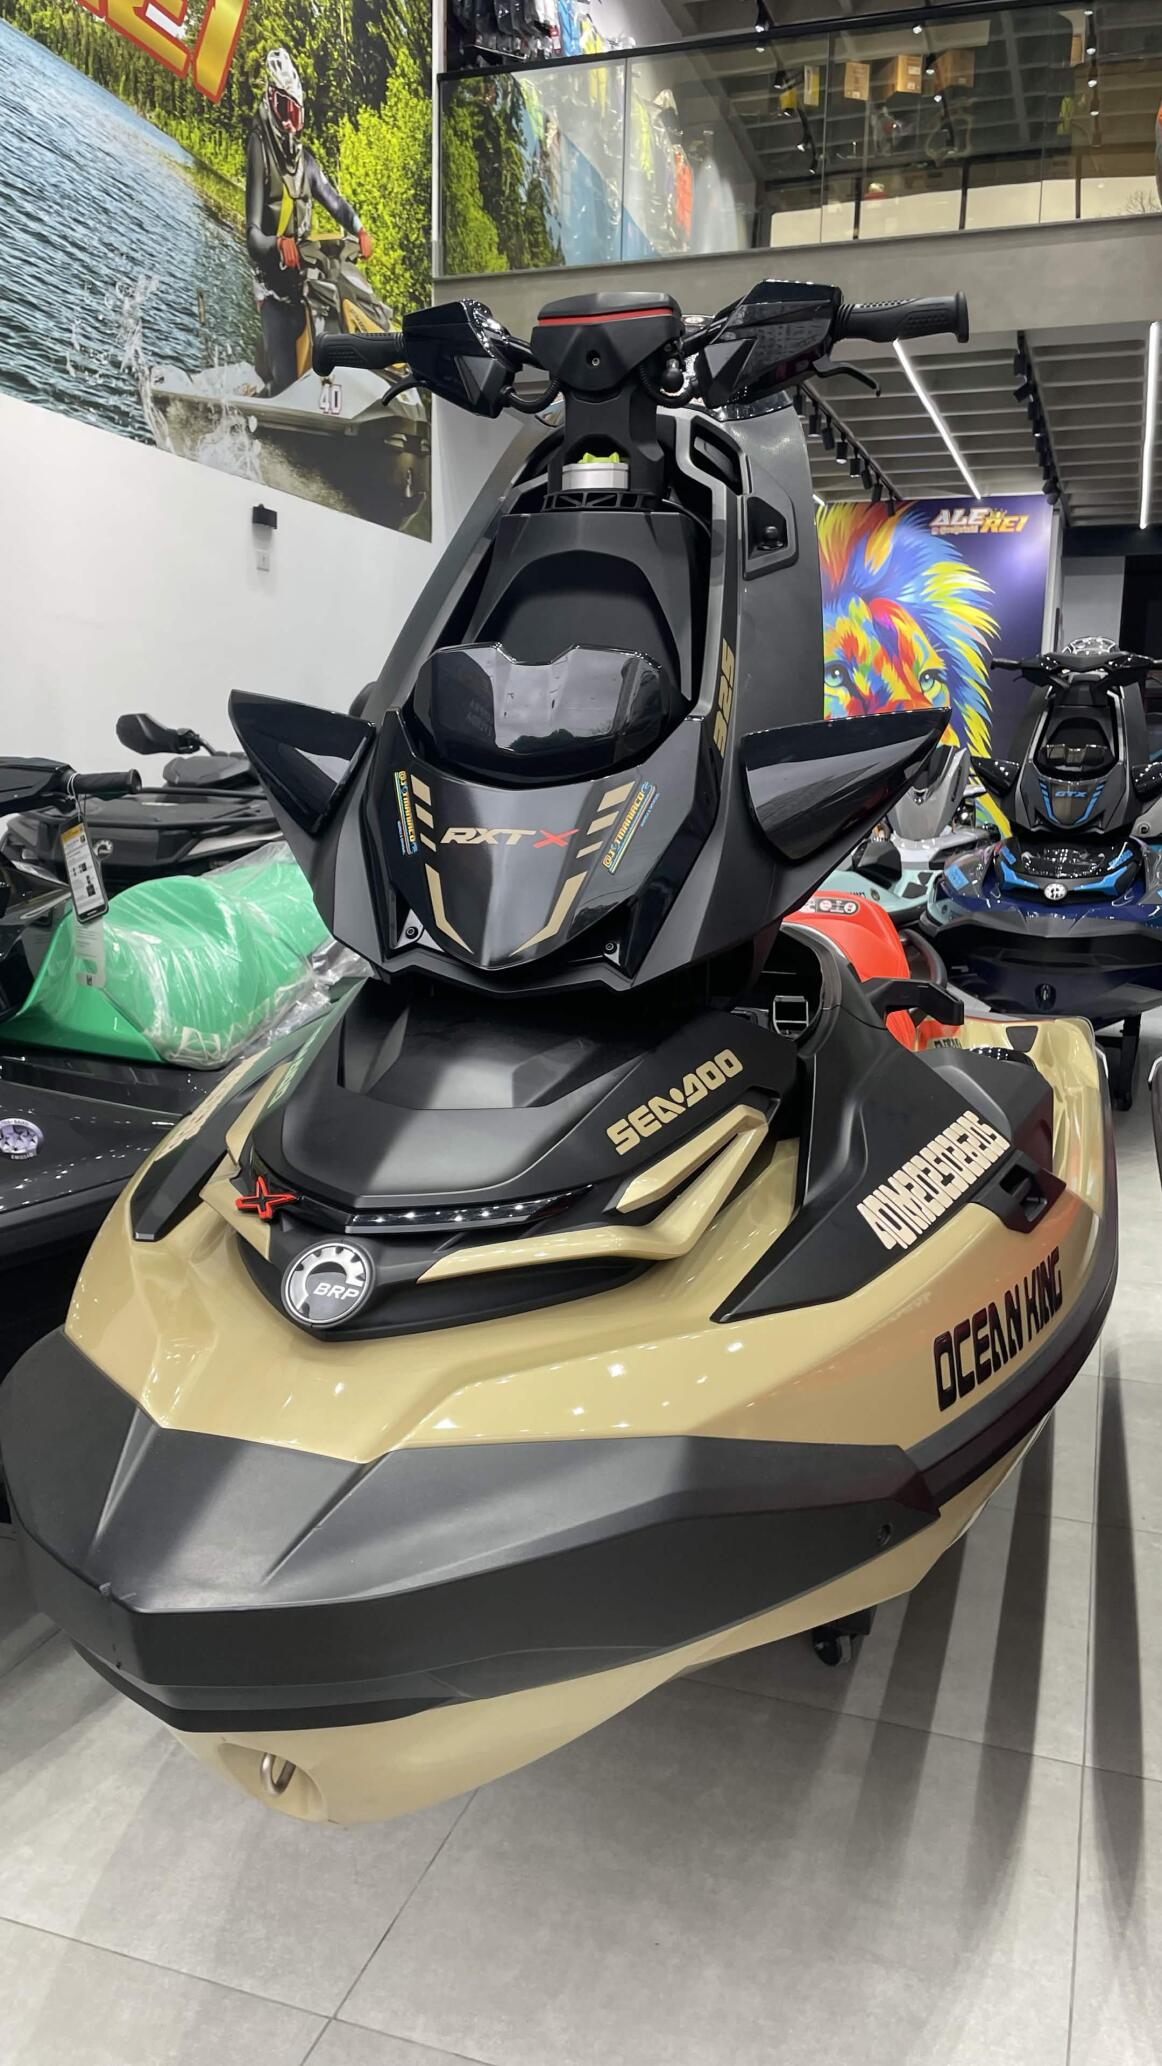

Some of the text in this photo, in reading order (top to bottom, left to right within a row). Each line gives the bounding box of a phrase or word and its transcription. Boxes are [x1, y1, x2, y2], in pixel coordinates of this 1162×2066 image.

[319, 383, 342, 415] 40
[929, 507, 990, 527] ALE
[980, 514, 1029, 533] REI
[713, 637, 735, 759] 325
[313, 1282, 360, 1300] BRP
[933, 1245, 1063, 1412] OCEAN KING
